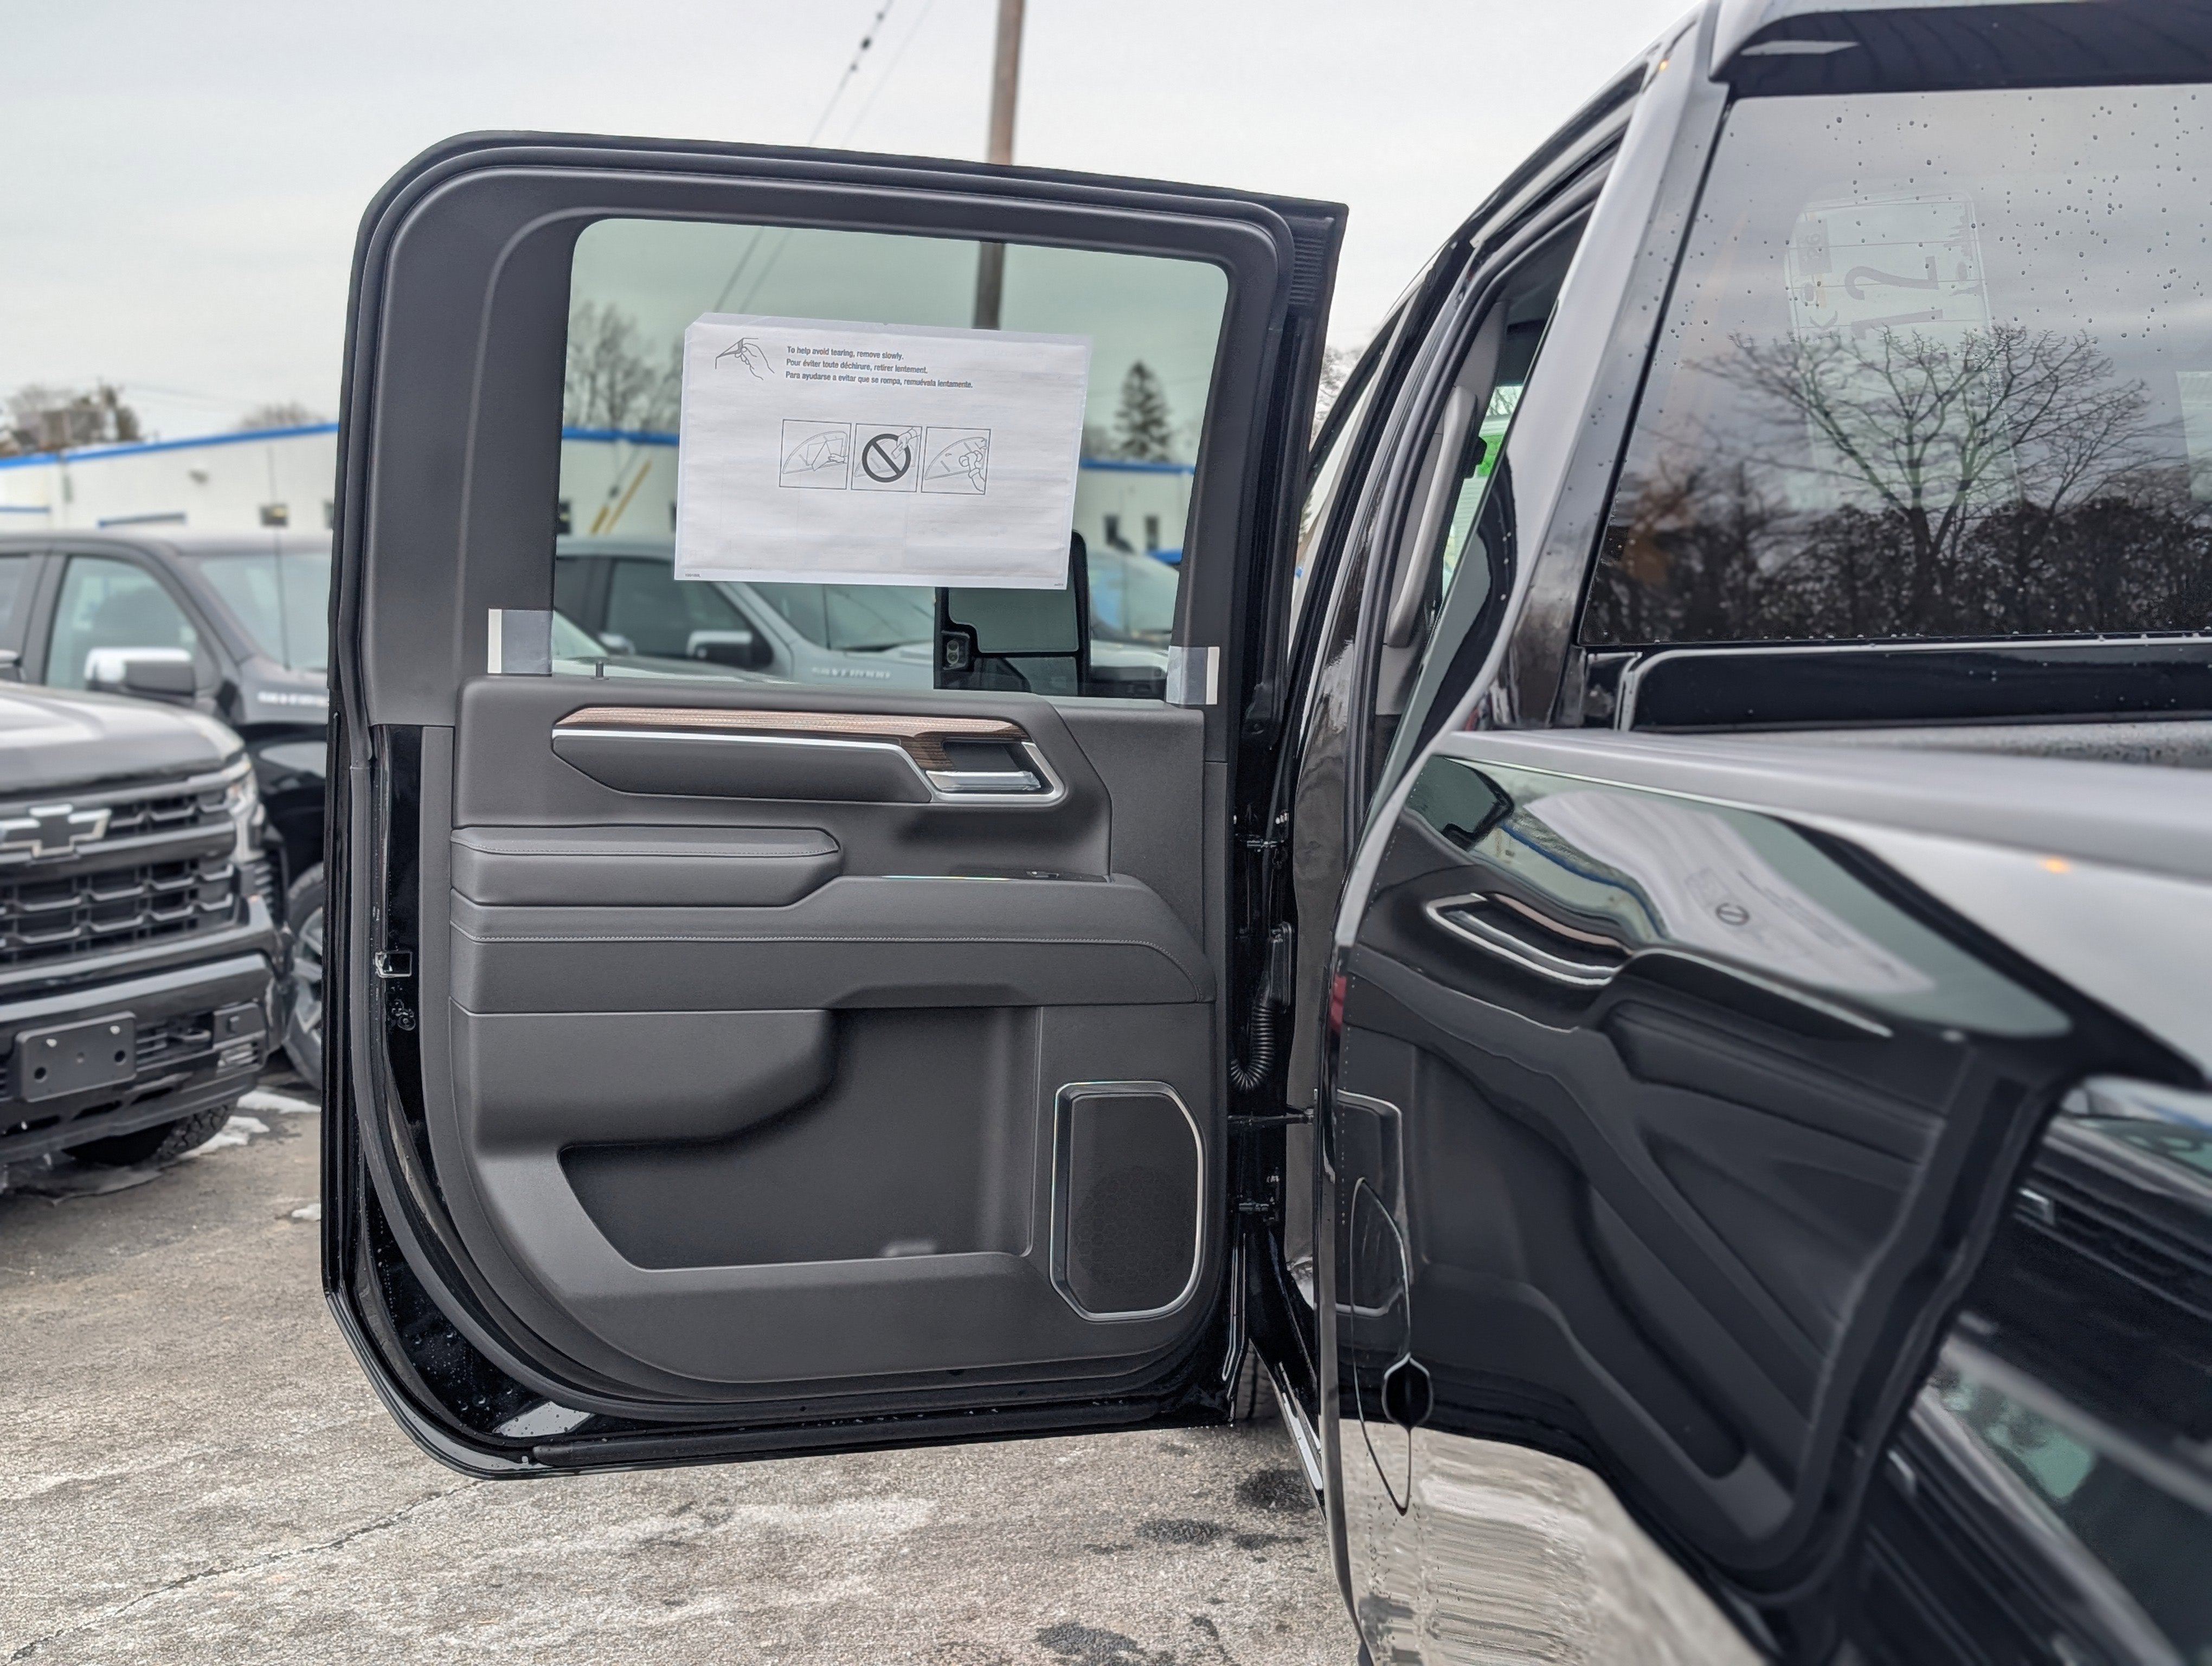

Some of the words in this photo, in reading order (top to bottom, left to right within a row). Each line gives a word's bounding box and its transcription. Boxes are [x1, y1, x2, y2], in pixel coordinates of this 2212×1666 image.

[796, 347, 811, 356] help
[812, 348, 829, 356] avoid
[831, 349, 856, 358] tearing,
[882, 352, 904, 361] slowly.
[803, 360, 821, 368] éviter
[822, 361, 839, 369] toute
[840, 362, 873, 371] déchirure,
[874, 364, 893, 372] retirer
[786, 371, 800, 379] Para
[802, 373, 831, 381] ayudarse
[858, 376, 870, 384] que
[880, 378, 902, 386] rompa,
[938, 380, 973, 388] lentamente.
